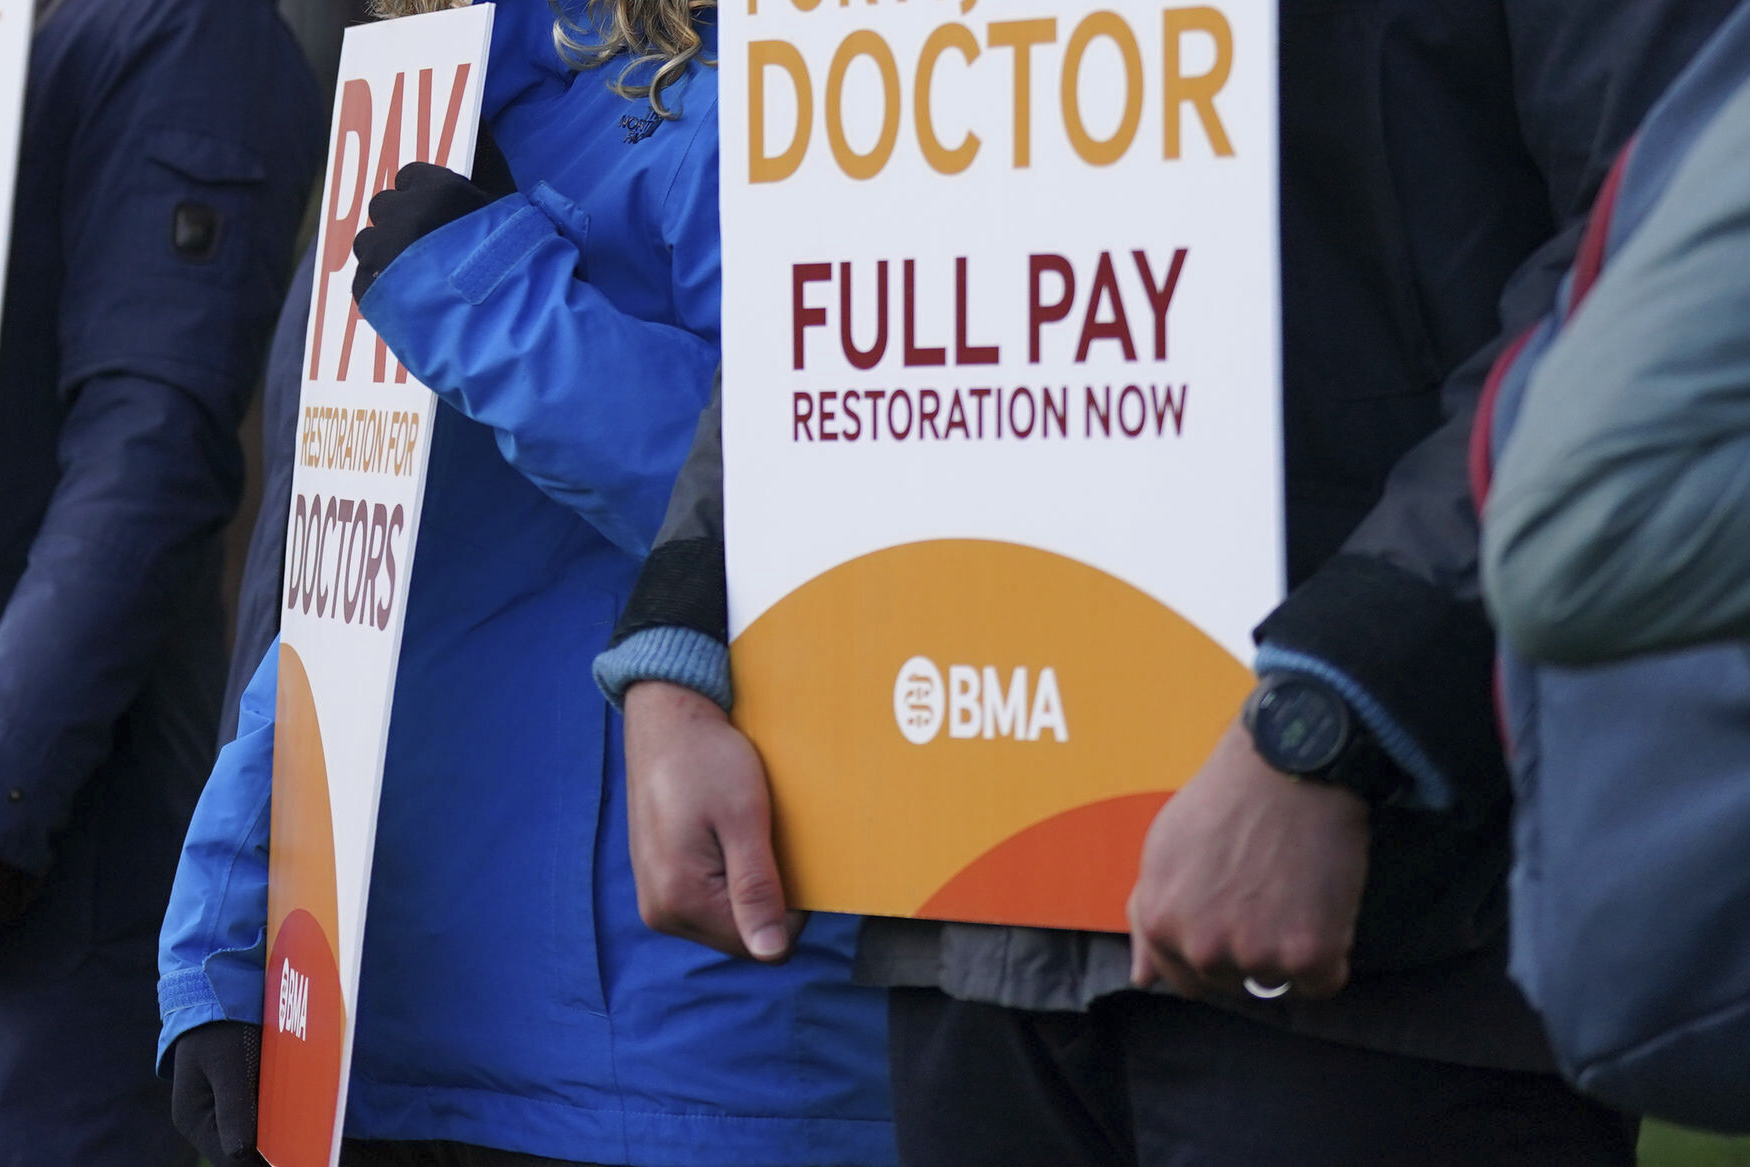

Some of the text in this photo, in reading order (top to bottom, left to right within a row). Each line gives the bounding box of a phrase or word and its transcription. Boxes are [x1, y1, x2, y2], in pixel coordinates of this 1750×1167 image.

[748, 5, 1237, 185] DOCTOR
[792, 248, 1189, 370] FULL PAY
[300, 406, 420, 477] RESTORATION FOR
[793, 383, 1188, 442] RESTORATION NOW
[287, 493, 404, 632] DOCTORS
[949, 664, 1069, 743] BMA
[285, 967, 309, 1042] BMA
